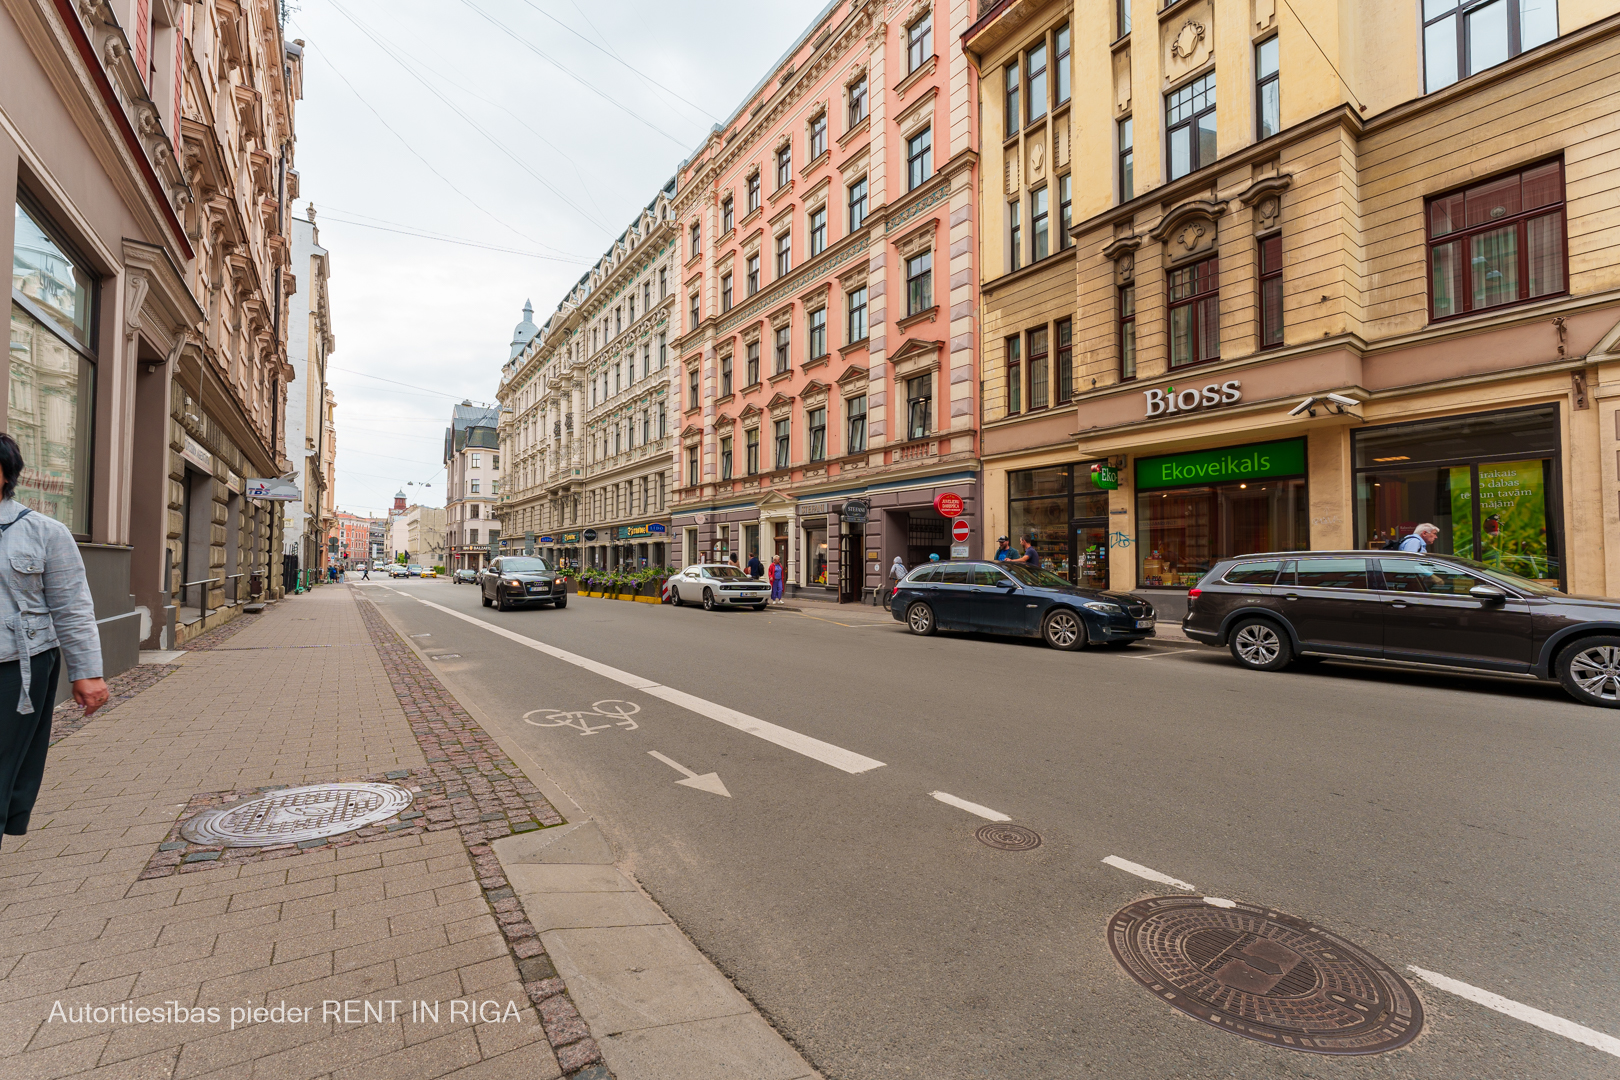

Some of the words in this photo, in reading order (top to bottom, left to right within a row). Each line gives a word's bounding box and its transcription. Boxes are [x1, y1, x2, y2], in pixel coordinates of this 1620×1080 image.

[45, 255, 54, 277] LA
[40, 269, 58, 300] LUNA
[1143, 380, 1242, 418] Bioss
[1162, 451, 1271, 481] Ekoveikals
[1480, 470, 1517, 479] īrākais
[1488, 479, 1520, 488] dabas
[1498, 489, 1532, 497] tavām
[801, 504, 825, 514] STEFANI
[1480, 500, 1514, 509] mājām
